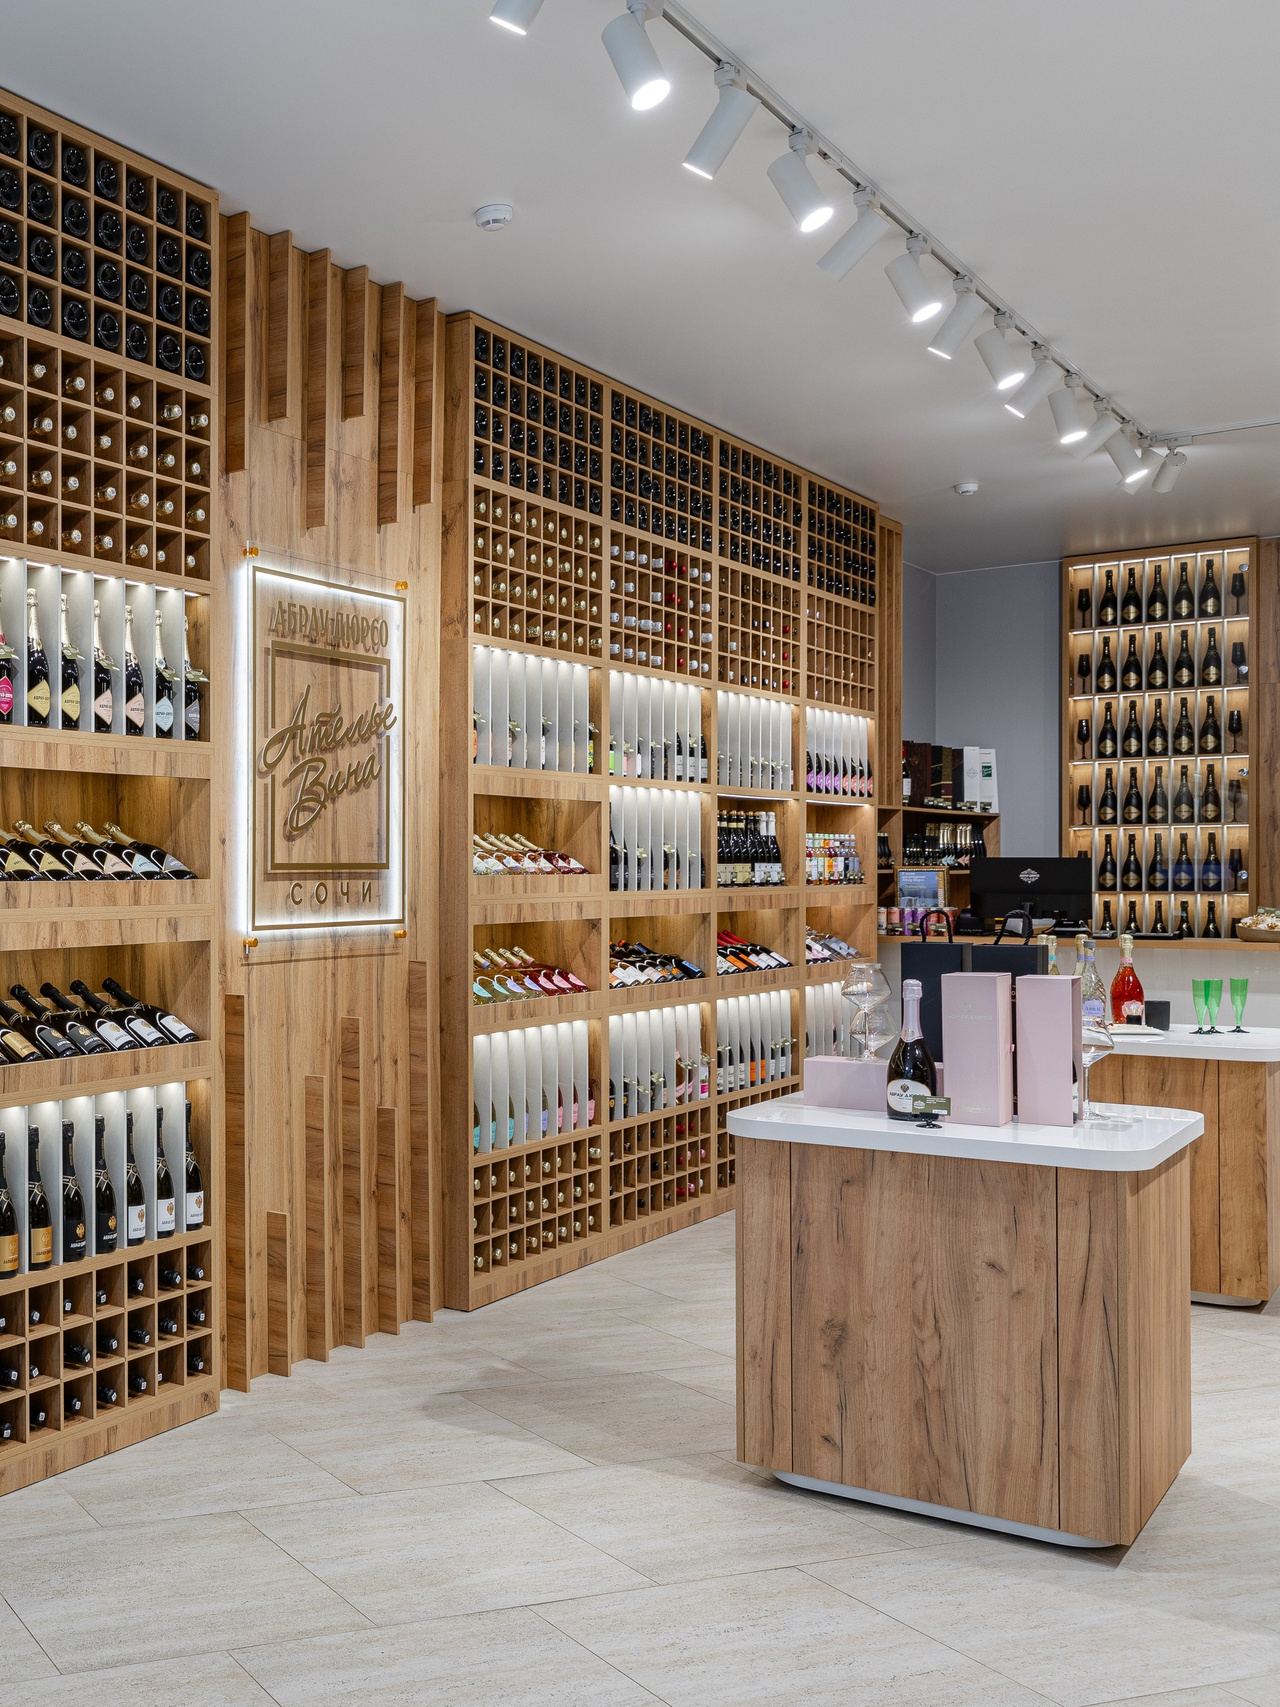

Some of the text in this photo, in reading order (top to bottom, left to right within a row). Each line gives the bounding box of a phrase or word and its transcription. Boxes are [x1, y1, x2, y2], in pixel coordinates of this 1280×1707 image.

[272, 600, 389, 648] АБРАУ ДЮРСО
[262, 683, 398, 770] Ателье
[287, 753, 382, 833] Вина
[290, 881, 373, 907] СОЧИ
